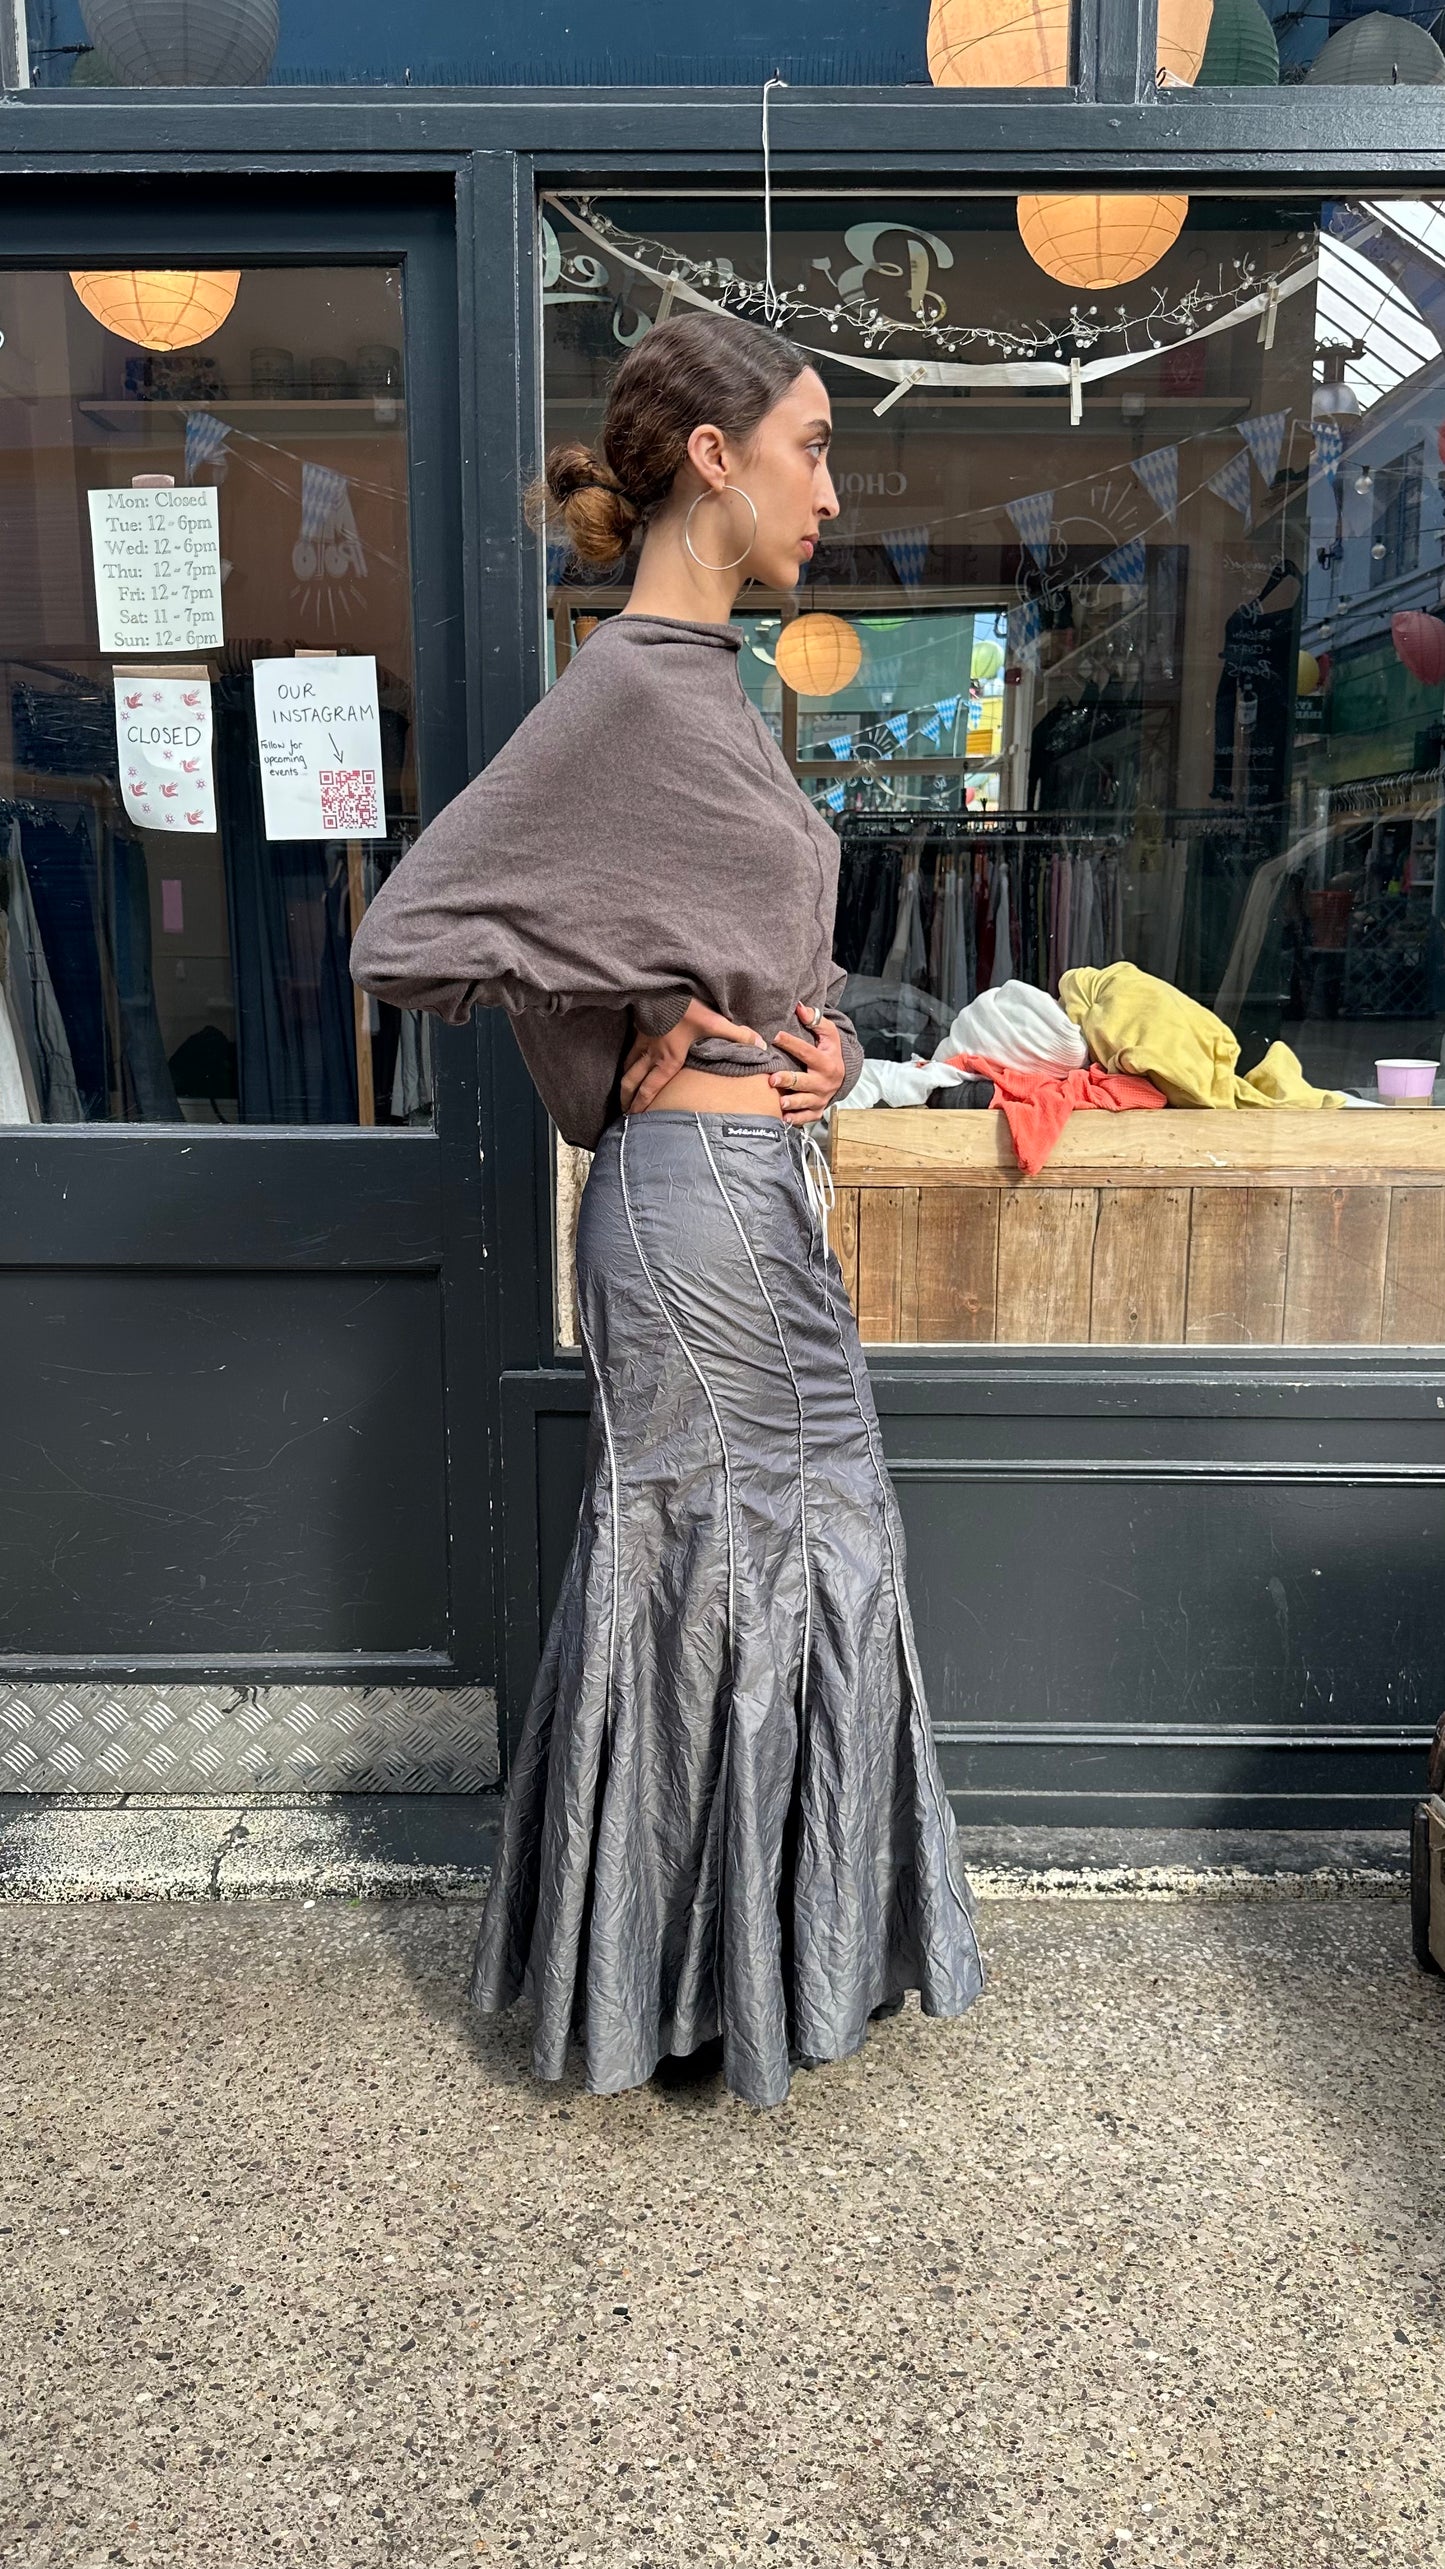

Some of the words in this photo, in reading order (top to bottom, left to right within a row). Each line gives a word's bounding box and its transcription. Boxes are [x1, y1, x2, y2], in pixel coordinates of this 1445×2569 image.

[107, 493, 149, 509] Mon:
[154, 491, 208, 508] Closed
[105, 517, 142, 532] Tue:
[104, 540, 149, 555] Wed:
[102, 563, 143, 579] Thu:
[118, 586, 146, 601] Fri:
[119, 609, 148, 624] Sat:
[114, 631, 150, 647] Sun:
[277, 682, 316, 700] OUR
[272, 704, 374, 724] INSTAGRAM
[127, 725, 202, 747] CLOSED
[260, 739, 285, 750] Follow
[288, 739, 303, 756] for
[263, 754, 308, 770] upcoming
[269, 766, 299, 777] events
